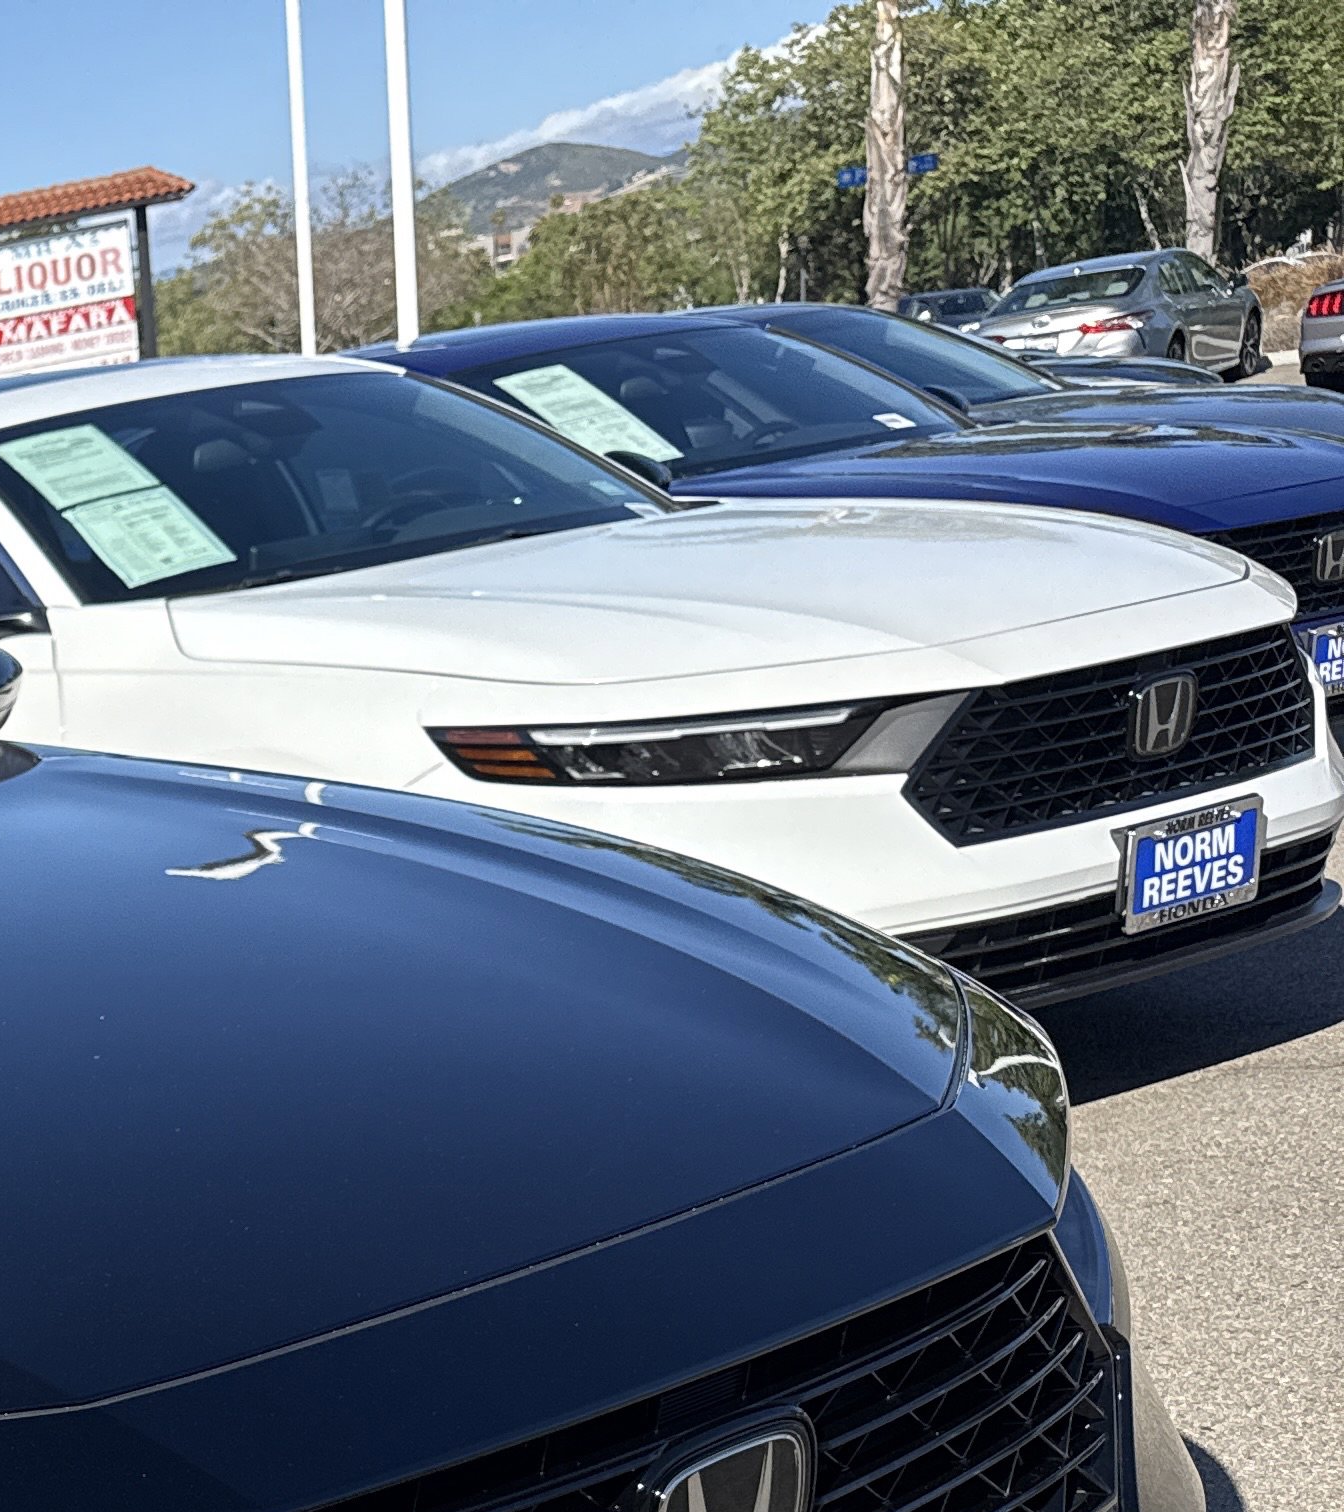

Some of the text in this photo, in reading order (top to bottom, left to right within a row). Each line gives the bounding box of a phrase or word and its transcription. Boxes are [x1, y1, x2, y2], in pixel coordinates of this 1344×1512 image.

[1154, 823, 1236, 873] NORM
[1142, 854, 1244, 908] REEVES
[1159, 893, 1228, 924] HONDA
